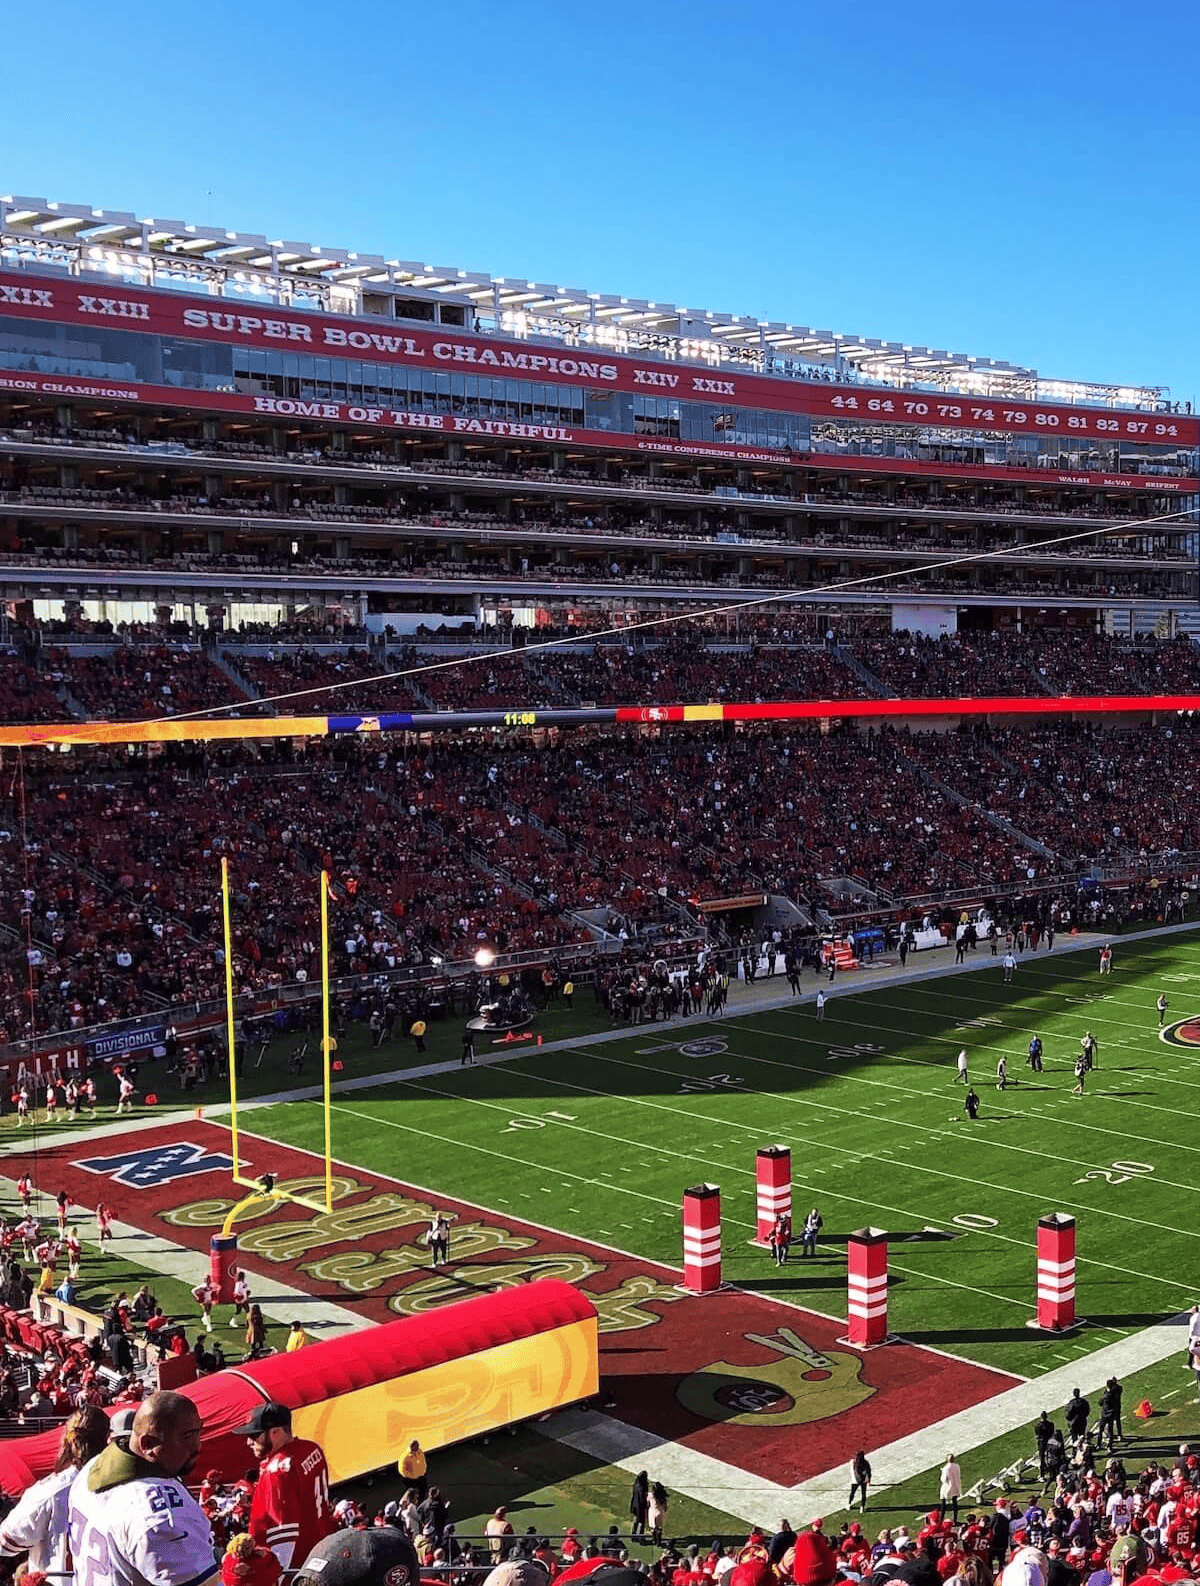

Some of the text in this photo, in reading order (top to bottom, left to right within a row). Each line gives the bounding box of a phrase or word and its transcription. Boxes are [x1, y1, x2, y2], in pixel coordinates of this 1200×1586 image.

[78, 295, 150, 320] XXIII
[183, 308, 618, 380] SUPER BOWL CHAMPIONS
[42, 383, 138, 399] CHAMPIONS
[633, 370, 736, 396] XXIV XXIX
[253, 397, 573, 441] HOME OF THE FAITHFUL
[831, 395, 858, 410] 44
[867, 399, 895, 413] 64
[903, 401, 929, 416] 70
[937, 404, 962, 418] 73
[971, 407, 995, 421] 74
[1002, 410, 1027, 424] 79
[1034, 412, 1060, 426] 80
[1067, 416, 1088, 429] 81
[1126, 421, 1149, 434] 87
[1154, 424, 1179, 437] 94
[674, 445, 735, 458] CONFERENCE
[95, 1032, 158, 1055] DIVISIONAL
[1176, 1531, 1190, 1545] 85
